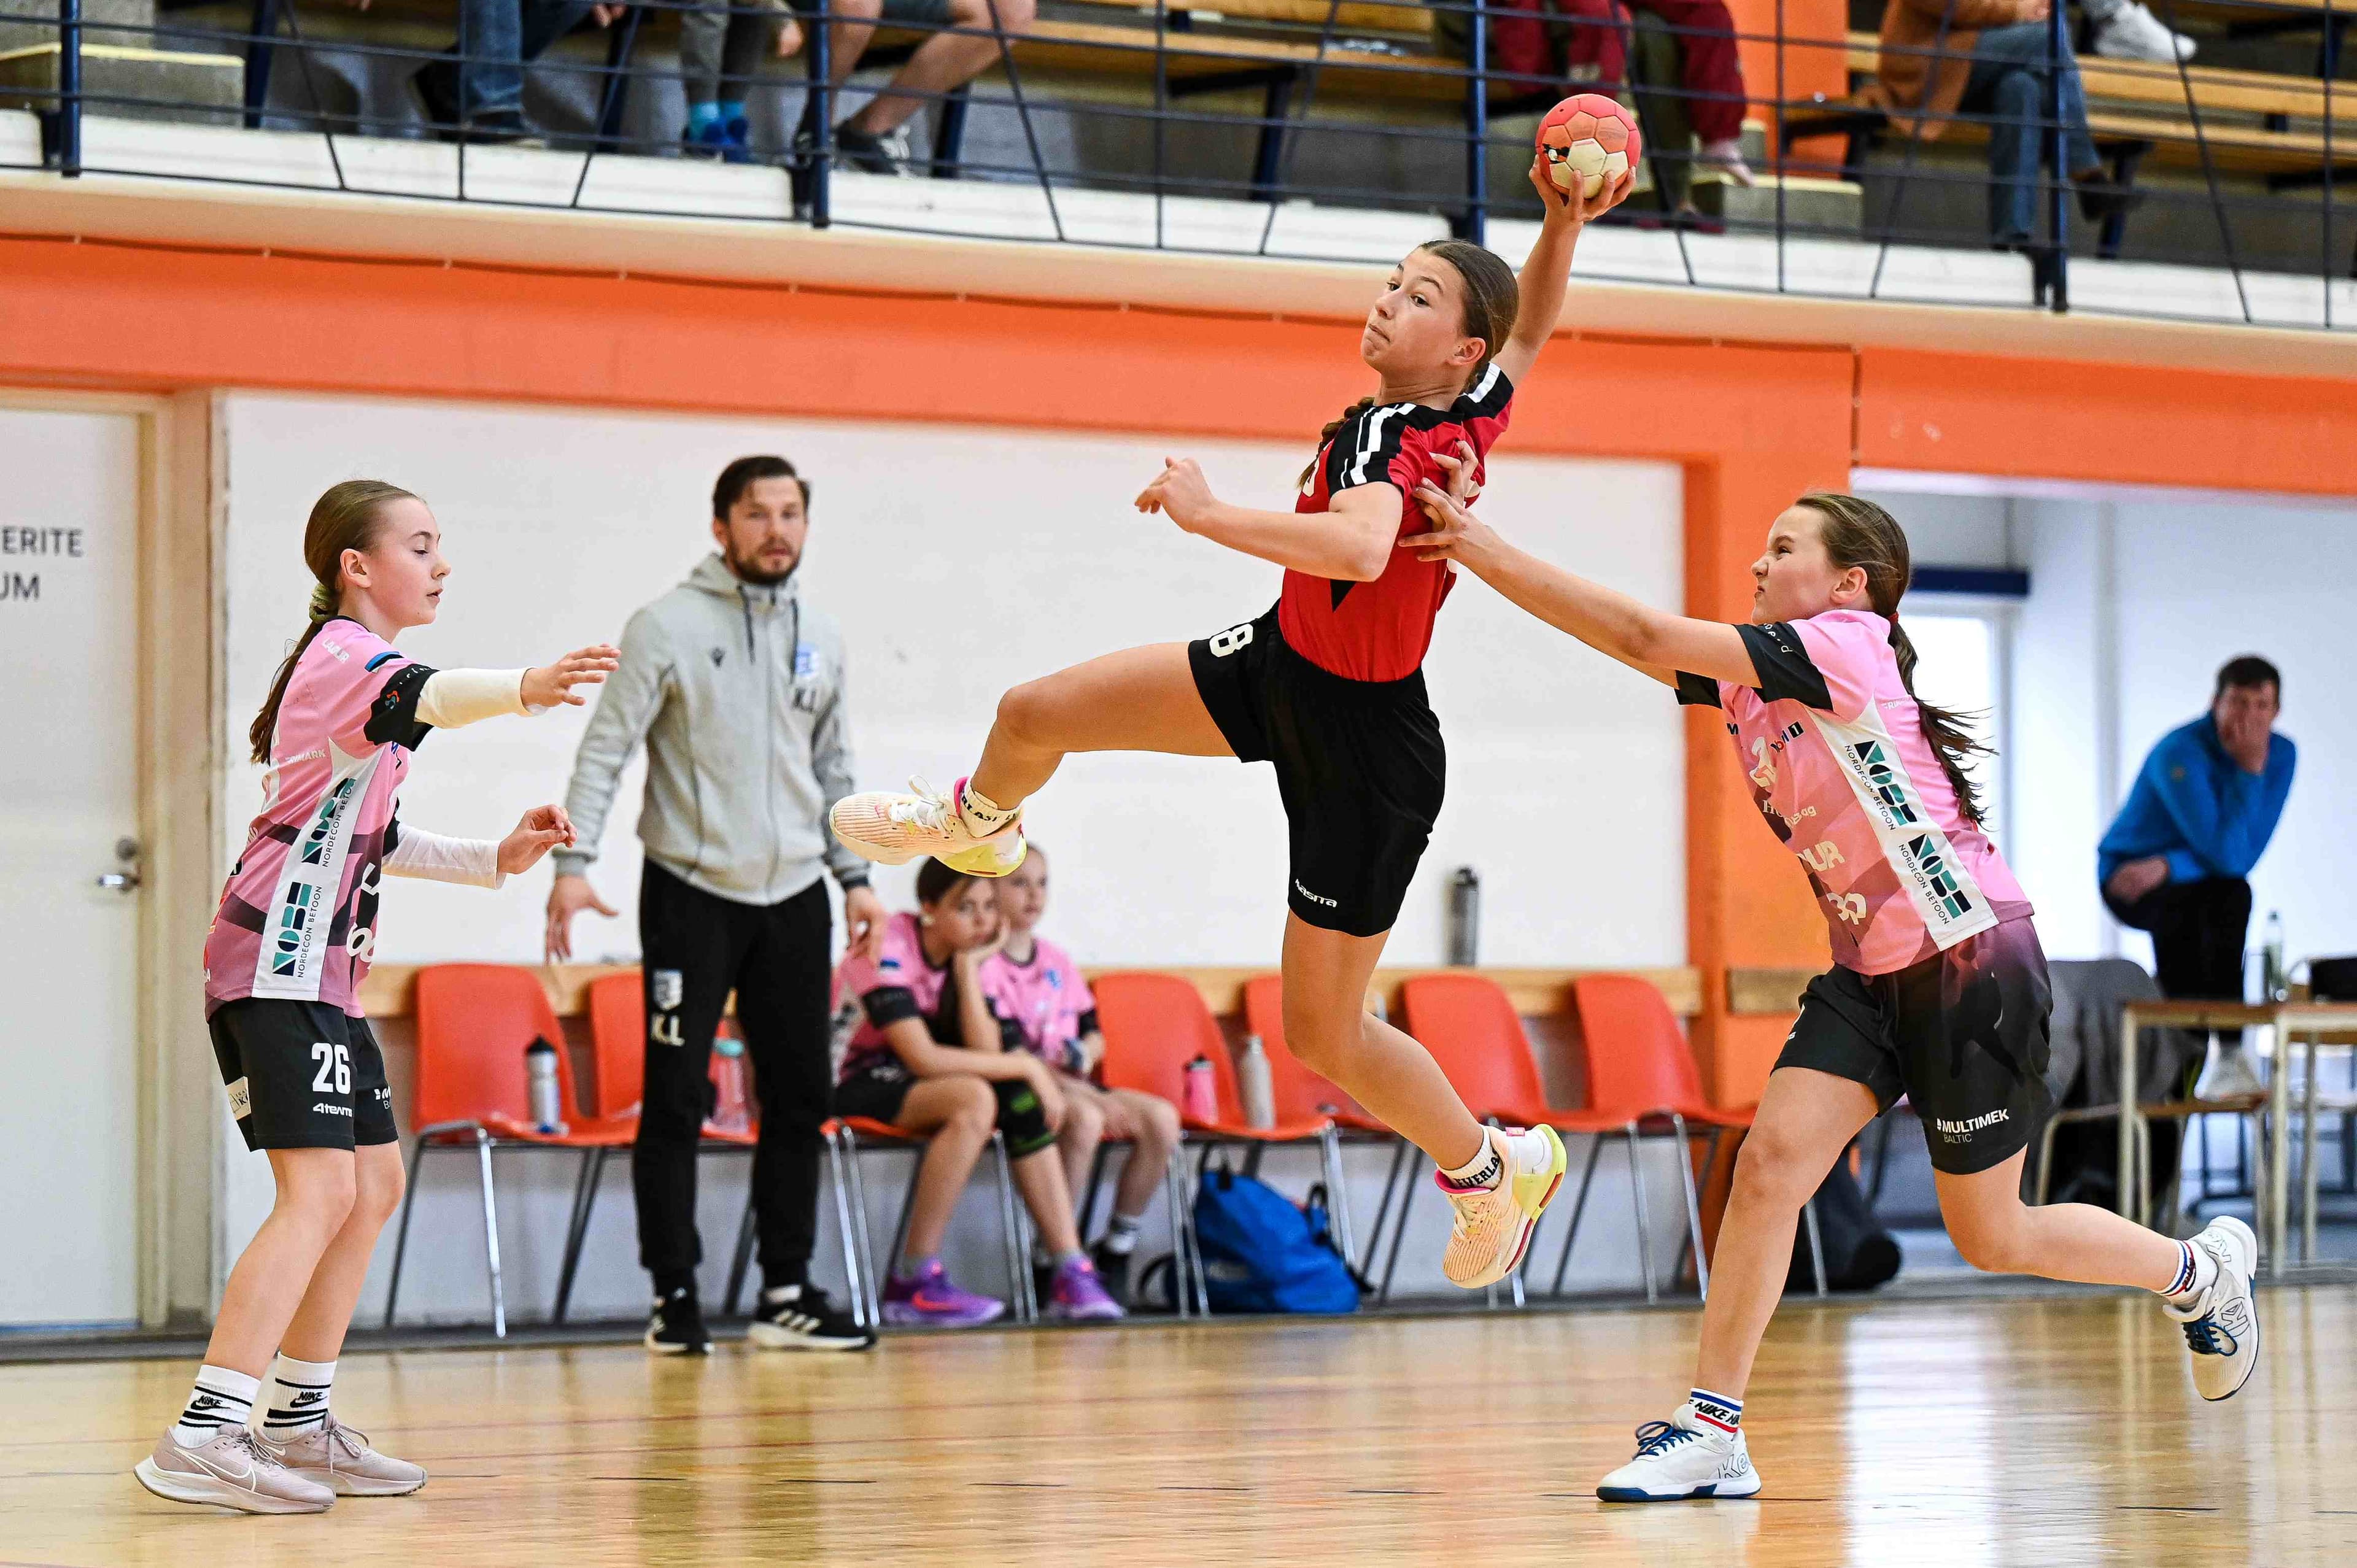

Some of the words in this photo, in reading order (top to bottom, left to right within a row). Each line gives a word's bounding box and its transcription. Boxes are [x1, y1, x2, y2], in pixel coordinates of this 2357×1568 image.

[1844, 745, 1875, 794] NORDECON
[1873, 796, 1895, 830] BETOON
[322, 815, 342, 867] NORDECON
[1898, 844, 1928, 889] NORDECON
[1925, 890, 1950, 924] BETOON
[298, 927, 312, 978] NORDECON
[308, 886, 322, 922] BETOON
[312, 1043, 351, 1095] 26
[1942, 1108, 2010, 1134] MULTIMEK
[1943, 1134, 1972, 1143] BALTIC
[198, 1395, 223, 1406] NIKE
[298, 1391, 323, 1402] NIKE
[1695, 1401, 1730, 1420] NIKE
